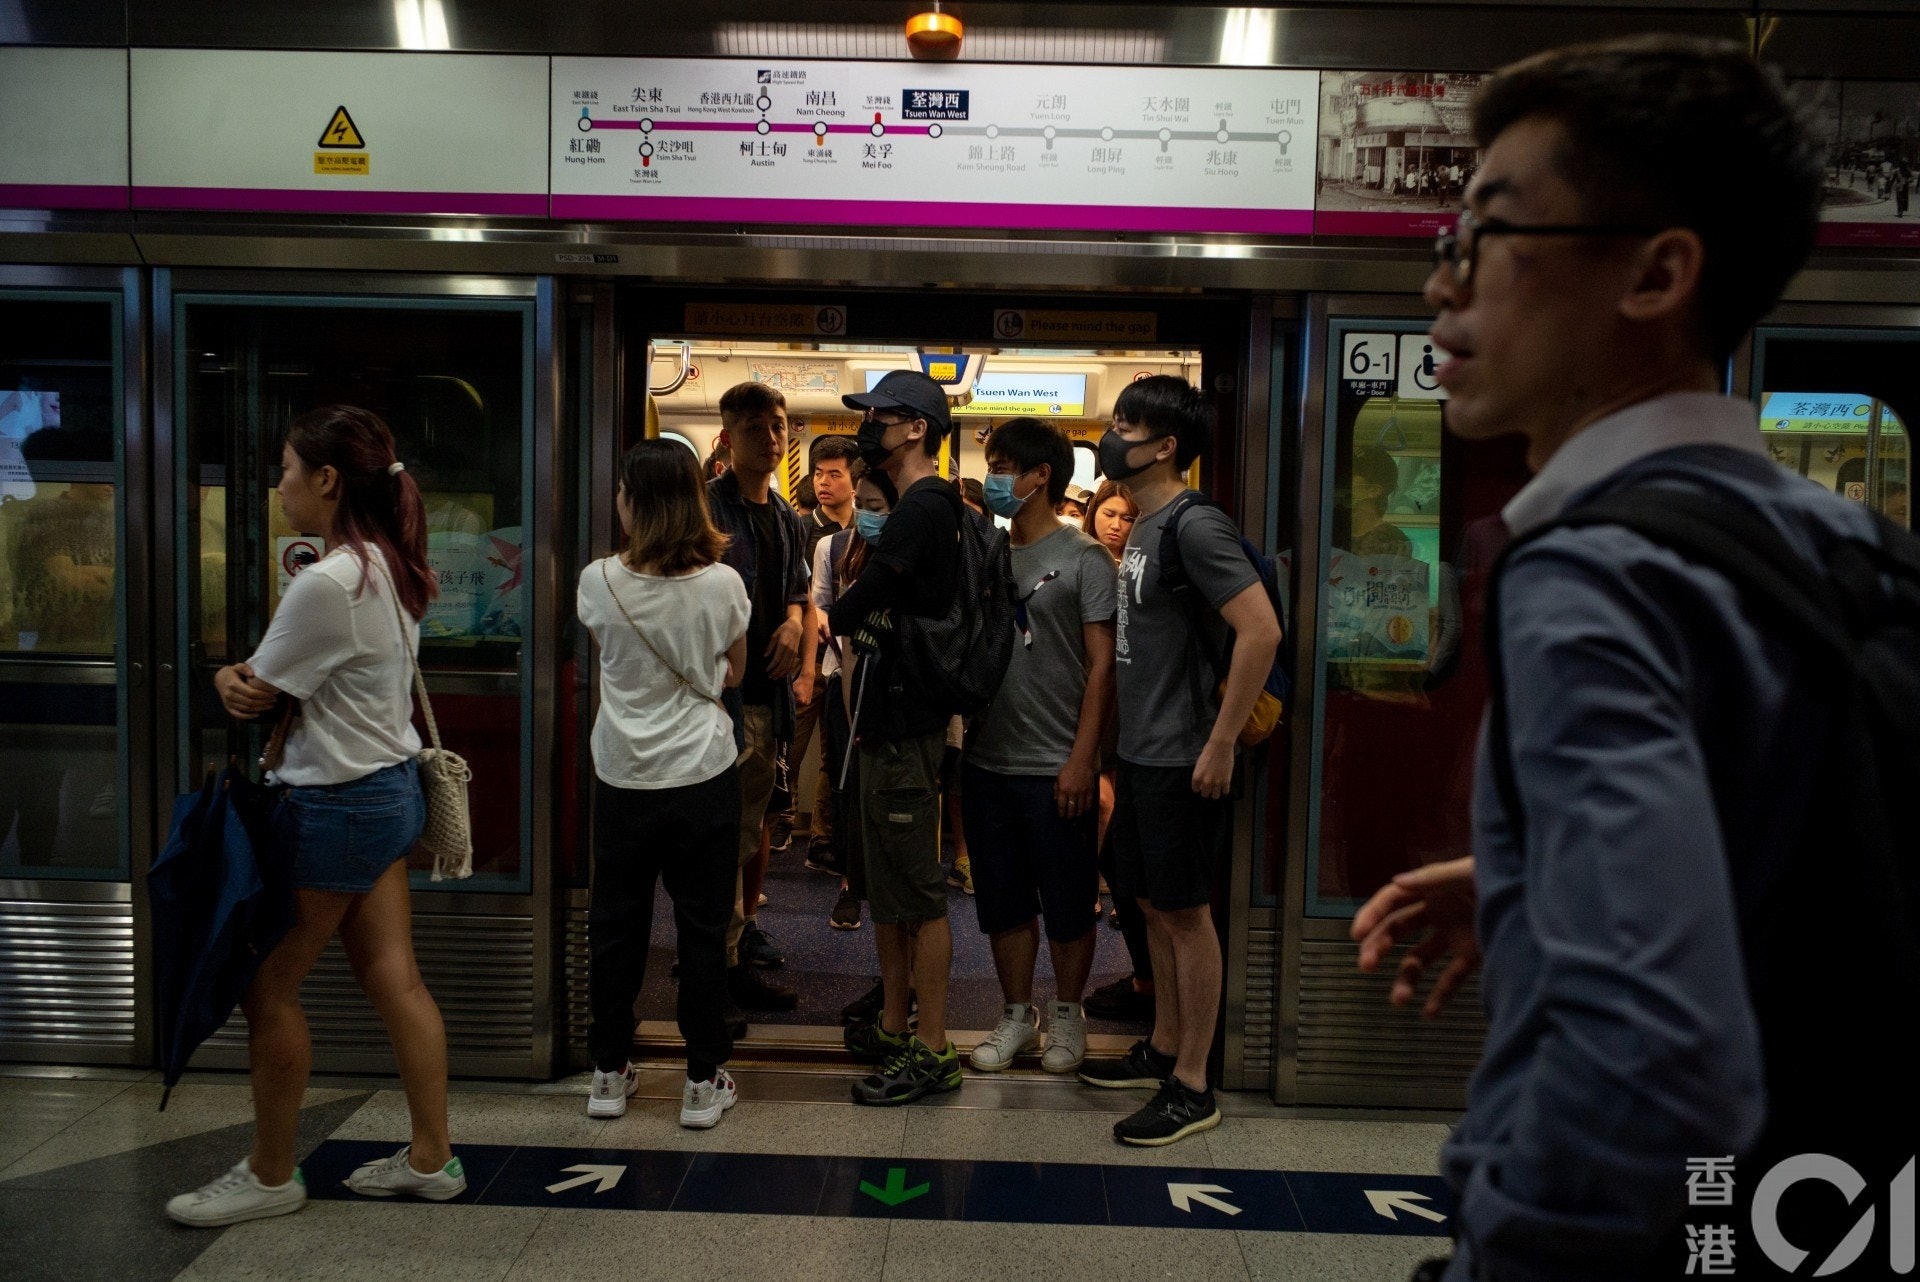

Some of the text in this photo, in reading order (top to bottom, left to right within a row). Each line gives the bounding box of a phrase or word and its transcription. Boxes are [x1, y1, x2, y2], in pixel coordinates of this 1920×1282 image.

[631, 87, 663, 103] 尖東
[700, 92, 754, 105] 香港西九龍
[806, 90, 836, 106] 南昌
[911, 92, 960, 109] 荃灣西
[1036, 94, 1067, 110] 元朗
[1143, 96, 1190, 113] 天水圍
[1271, 98, 1301, 115] 屯門
[613, 105, 681, 114] East Tsim Sha Tsui
[816, 108, 845, 117] Cheong
[905, 109, 966, 119] Tsuen Wan West
[1051, 113, 1071, 121] Long
[1143, 114, 1189, 123] Tin Shui Wai
[1266, 117, 1304, 125] Tuen Mun
[570, 138, 601, 153] 紅磡
[657, 140, 694, 153] 尖沙咀
[740, 141, 787, 157] 柯士甸
[862, 143, 893, 159] 美孚
[968, 144, 1016, 161] 錦上路
[1091, 148, 1122, 163] 朗屏
[1206, 150, 1238, 166] 兆康
[565, 156, 605, 165] Hung Hom
[750, 159, 775, 167] Austin
[862, 161, 892, 169] Mei Foo
[957, 163, 1026, 172] Kam Sheung Road
[1087, 166, 1125, 175] Long Ping
[1204, 168, 1239, 177] Siu Hong
[1031, 320, 1151, 335] Please mind the gap
[1350, 341, 1390, 375] 6-1
[976, 388, 1059, 397] Tsuen Wan West
[1789, 402, 1853, 417] 荃灣西
[1072, 428, 1088, 437] gap
